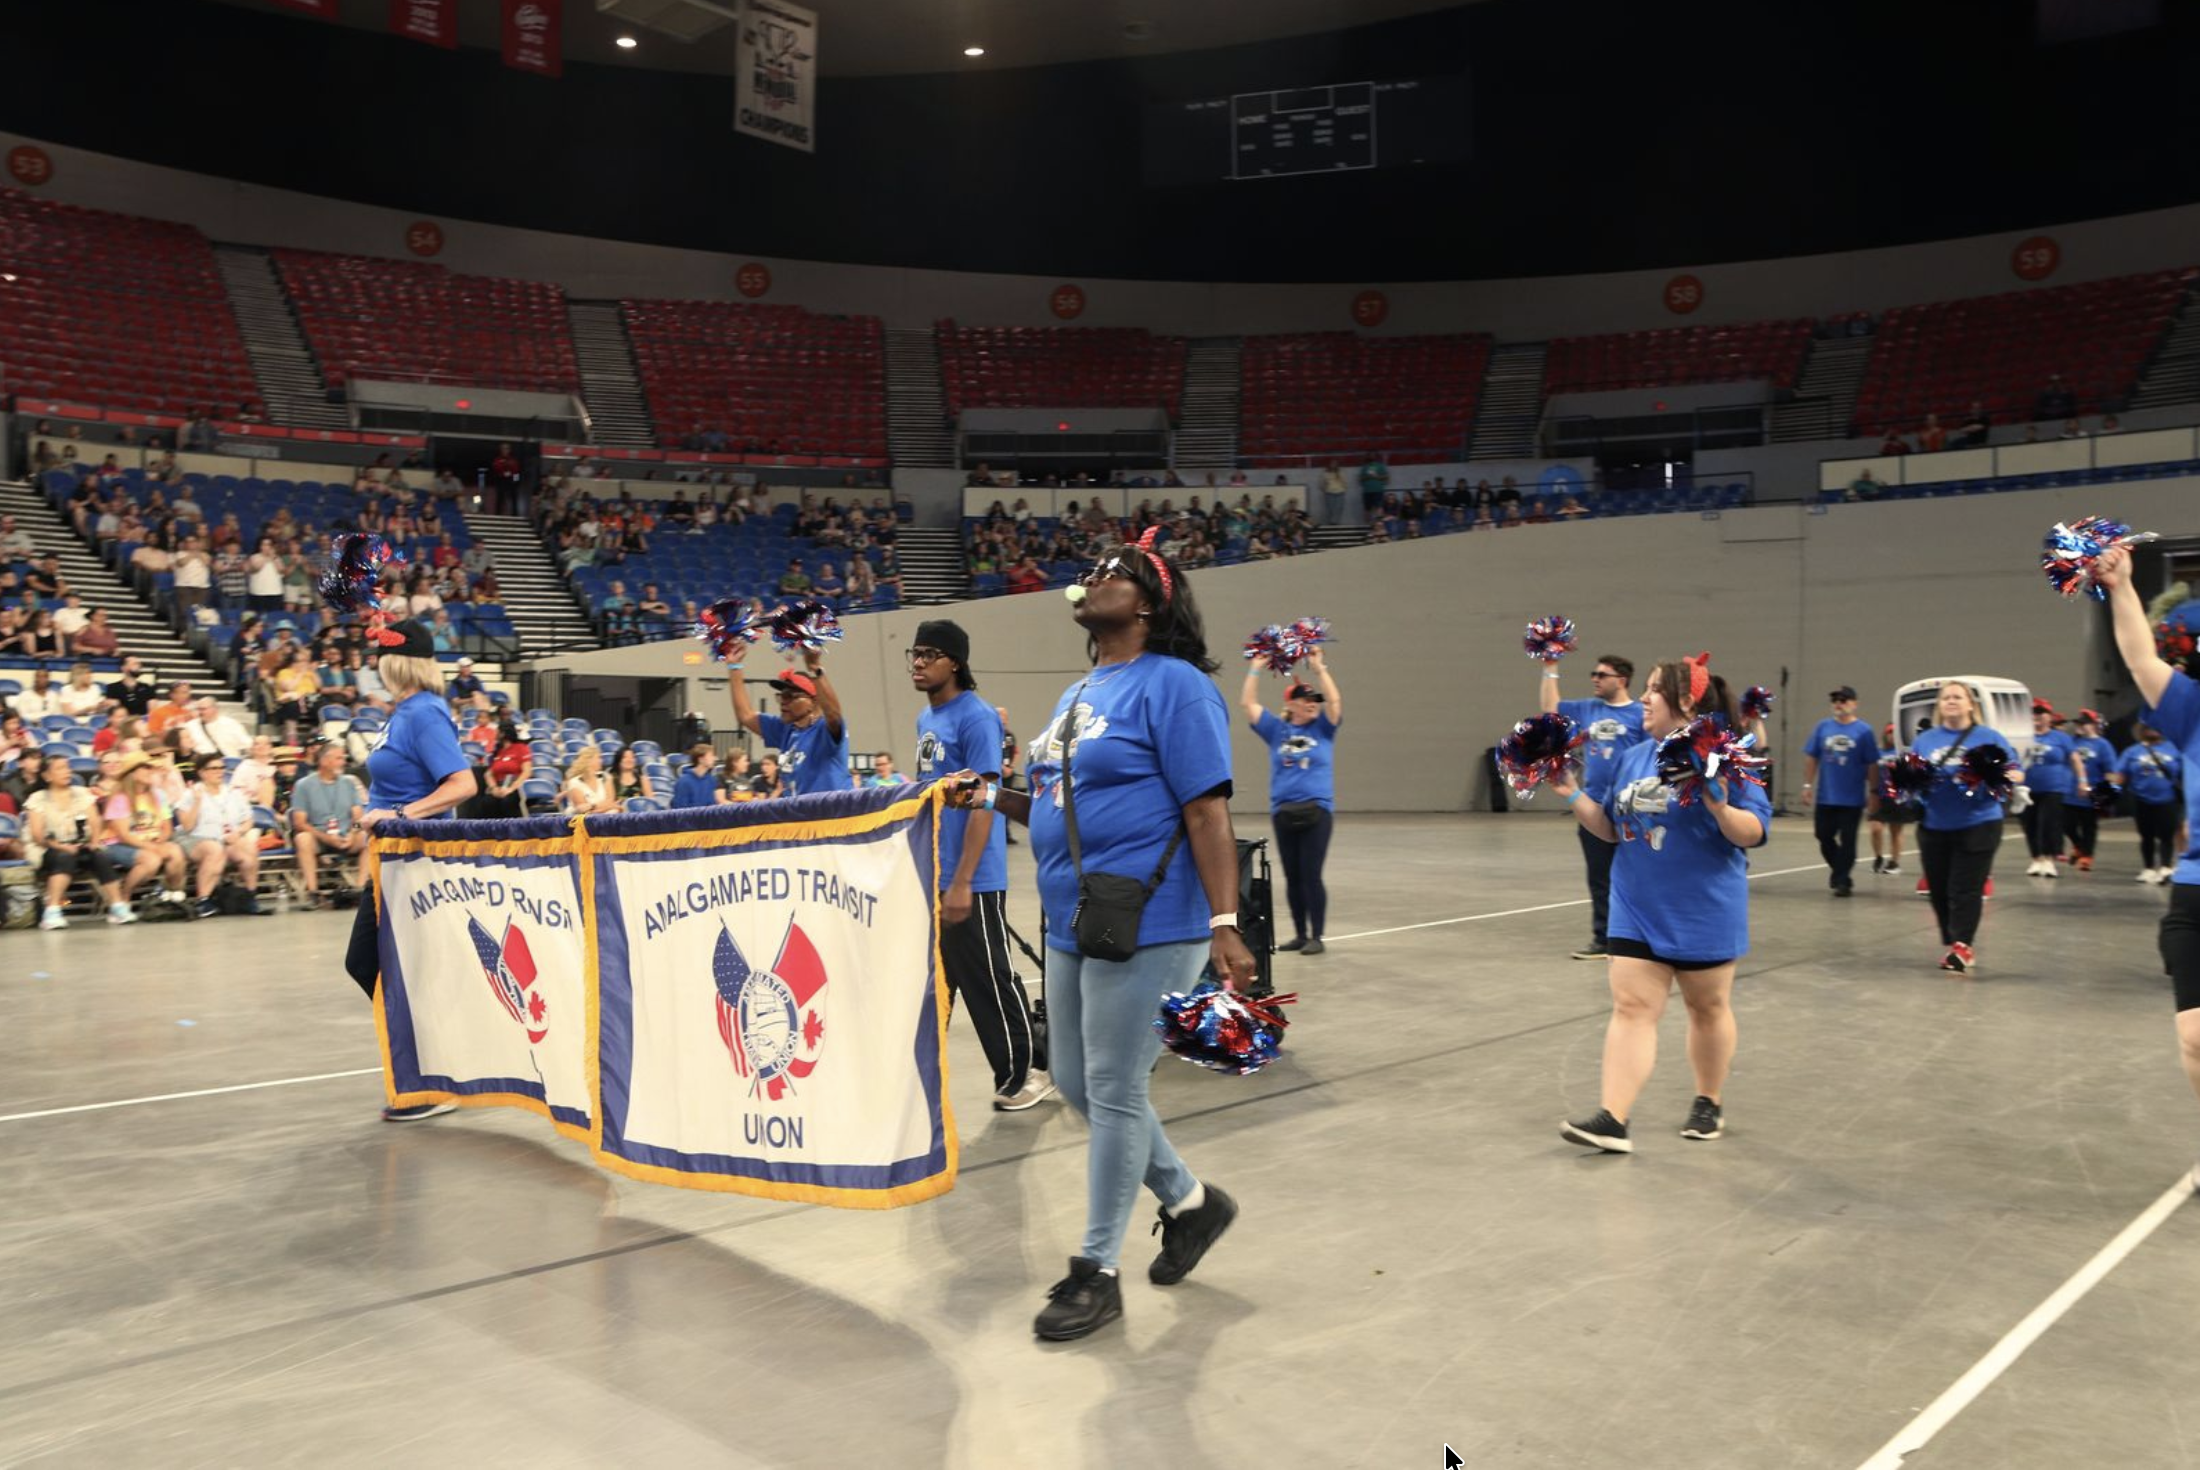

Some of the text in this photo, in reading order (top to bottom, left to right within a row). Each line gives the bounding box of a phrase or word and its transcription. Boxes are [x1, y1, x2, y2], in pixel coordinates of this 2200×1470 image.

[14, 155, 45, 176] 53
[411, 230, 436, 248] 54
[2019, 246, 2053, 271] 59
[738, 272, 765, 290] 55
[1671, 285, 1698, 305] 58
[1357, 299, 1381, 318] 57
[645, 868, 789, 940] AMALGAMAED
